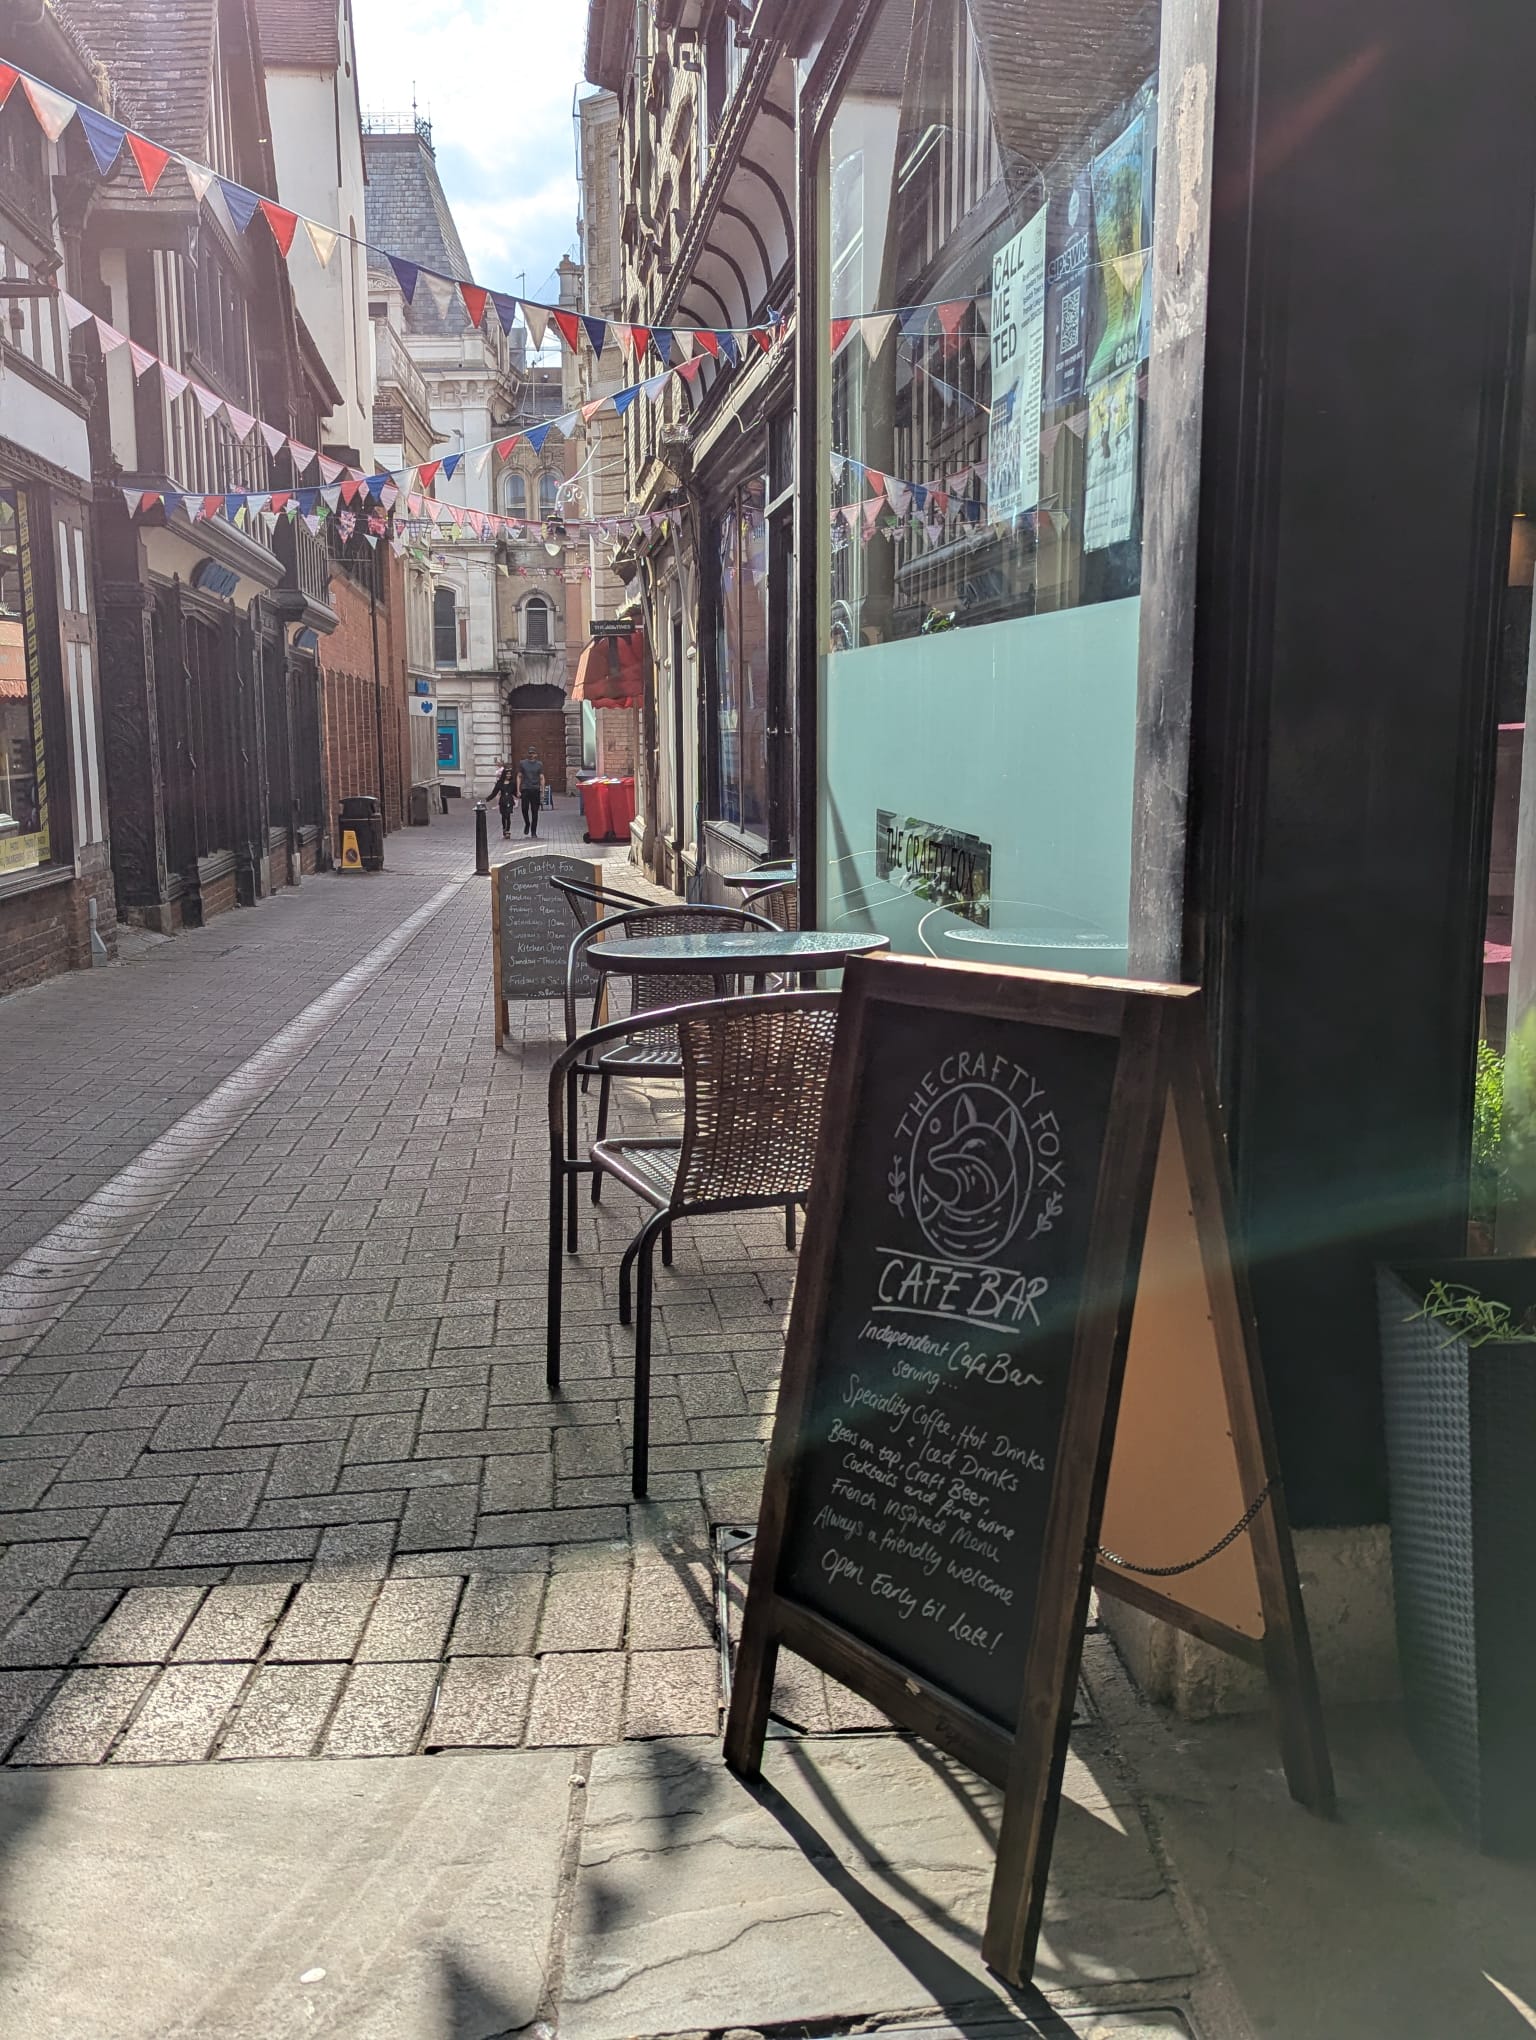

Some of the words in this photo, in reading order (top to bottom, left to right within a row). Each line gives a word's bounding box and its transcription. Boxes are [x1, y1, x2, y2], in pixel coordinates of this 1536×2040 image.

[994, 237, 1024, 292] CALL
[993, 286, 1011, 331] ME
[993, 323, 1017, 368] TED
[510, 866, 527, 877] The
[529, 862, 555, 873] Crafty
[559, 861, 574, 872] Fox
[887, 826, 904, 868] THE
[906, 834, 948, 883] CRAFTY
[950, 848, 977, 897] FOX
[517, 942, 545, 953] Kitchen
[894, 1071, 939, 1138] THE
[940, 1052, 1045, 1107] CRAFTY
[1030, 1111, 1065, 1187] FOX
[879, 1259, 972, 1311] CAFE
[967, 1269, 1048, 1326] BAR
[858, 1321, 950, 1357] Independent
[948, 1342, 987, 1379] Cafe
[985, 1353, 1044, 1386] Bar
[828, 1418, 857, 1446] Beers
[860, 1438, 874, 1453] on
[905, 1462, 945, 1490] Craft
[843, 1374, 911, 1433] Speciality
[957, 1425, 988, 1449] Hot
[992, 1435, 1045, 1471] Drinks
[842, 1453, 899, 1488] Cocktails
[904, 1486, 938, 1506] and
[977, 1518, 1015, 1541] wine
[919, 1440, 957, 1469] Iced
[959, 1455, 1019, 1491] Drinks
[831, 1478, 876, 1510] French
[884, 1499, 947, 1536] Inspired
[950, 1527, 1000, 1562] Menu
[813, 1505, 864, 1540] Always
[868, 1532, 877, 1543] a
[879, 1528, 943, 1576] friendly
[947, 1560, 1015, 1606] welcome
[821, 1549, 864, 1584] Open
[871, 1573, 918, 1620] Early
[949, 1612, 1004, 1656] Late!
